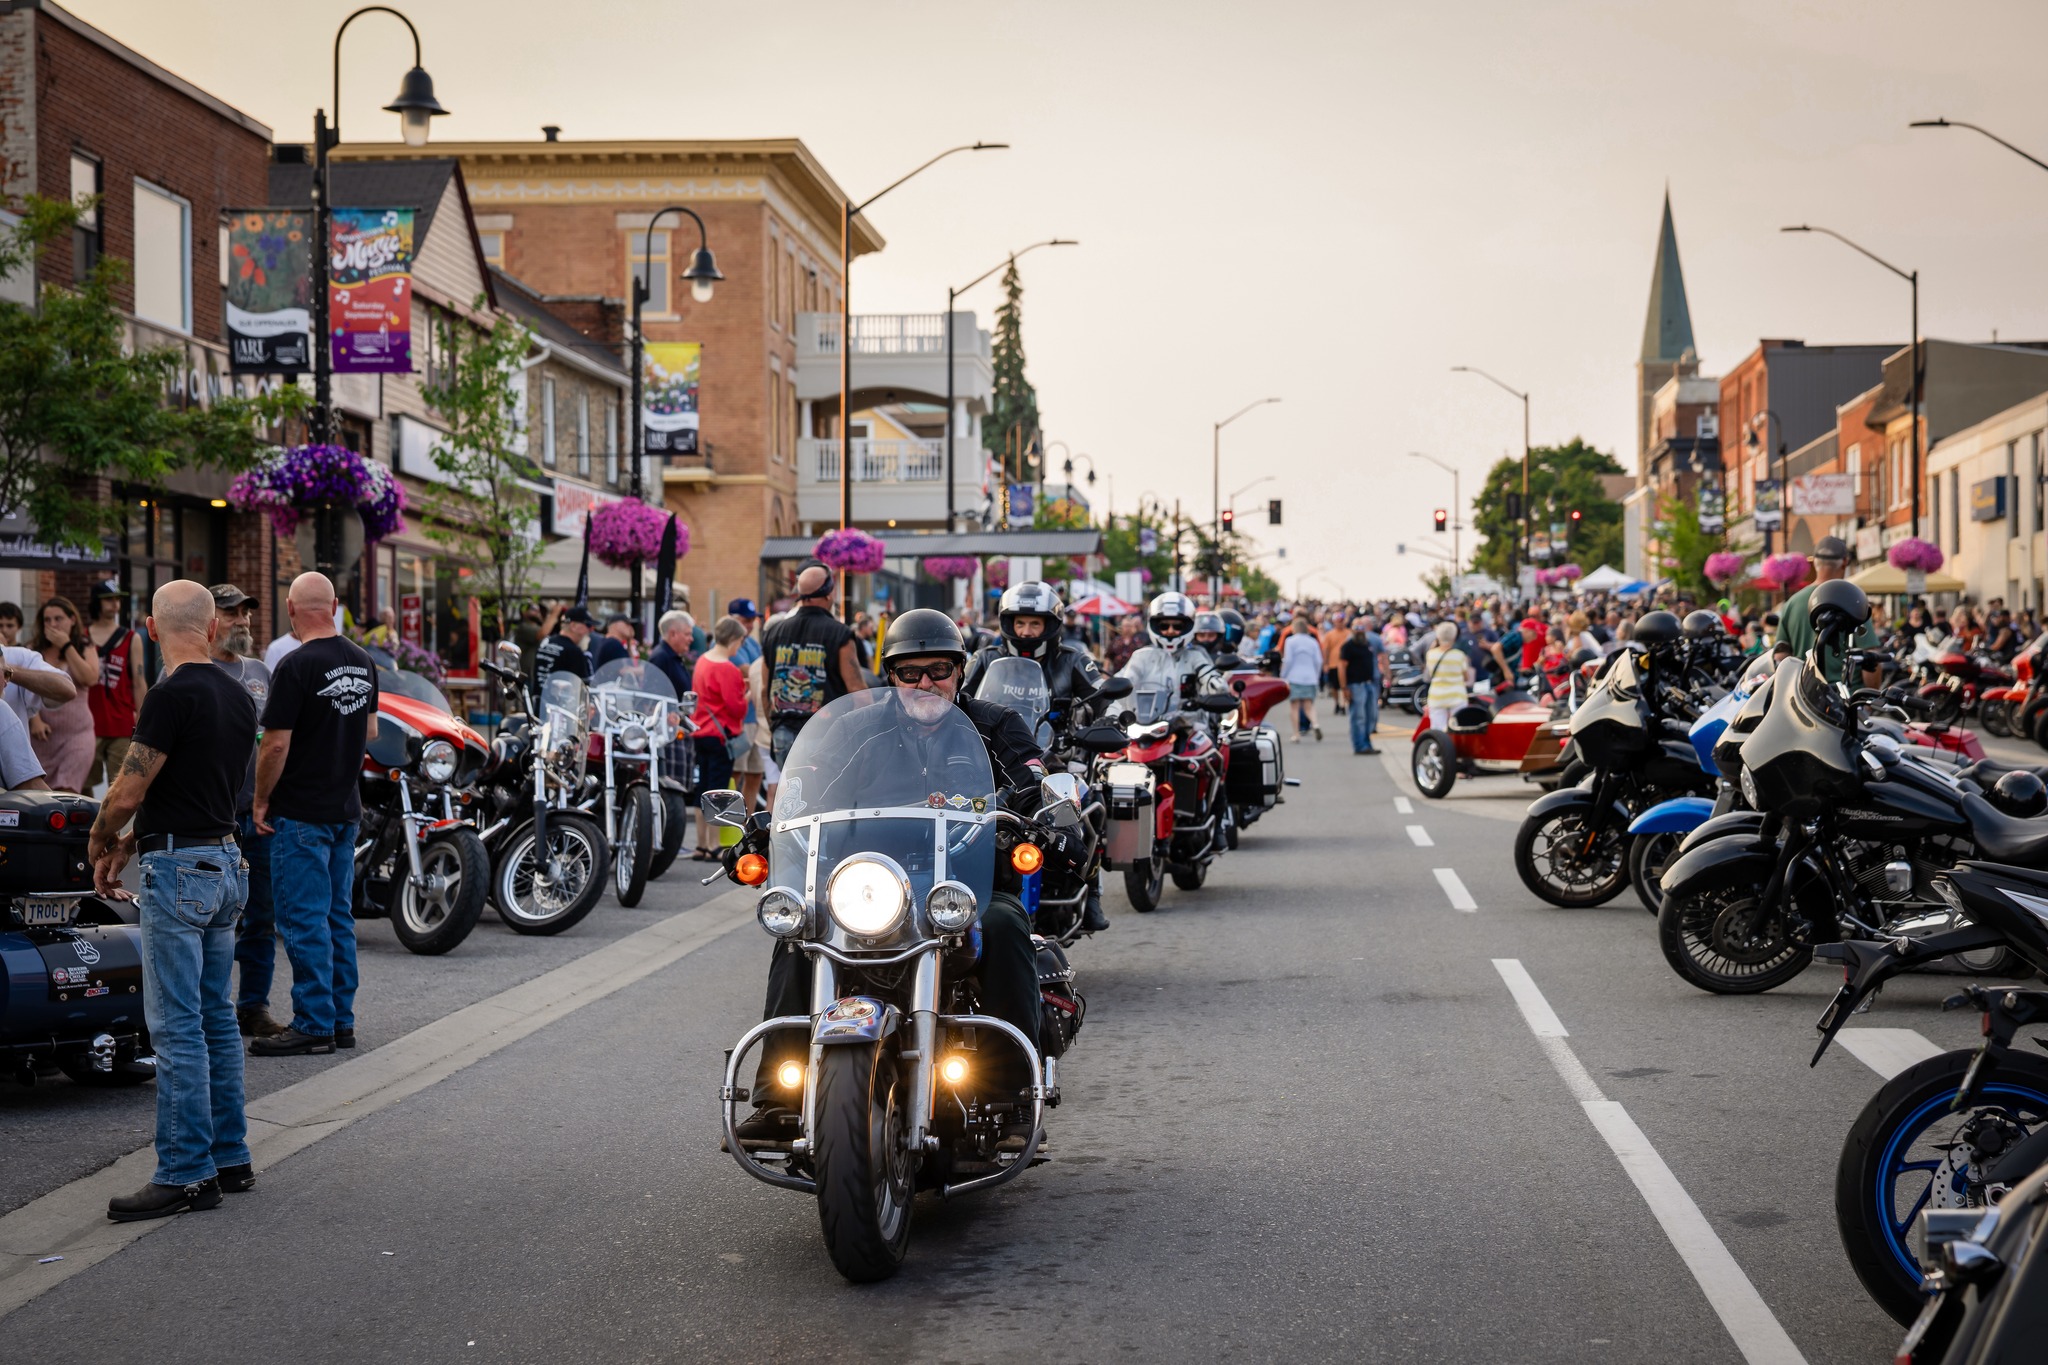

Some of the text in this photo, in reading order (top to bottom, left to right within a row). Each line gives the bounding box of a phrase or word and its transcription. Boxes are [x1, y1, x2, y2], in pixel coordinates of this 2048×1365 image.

[332, 235, 400, 270] Music
[368, 263, 405, 278] FESTIVAL
[352, 301, 385, 311] Saturday
[344, 310, 383, 320] September
[241, 338, 265, 356] ART
